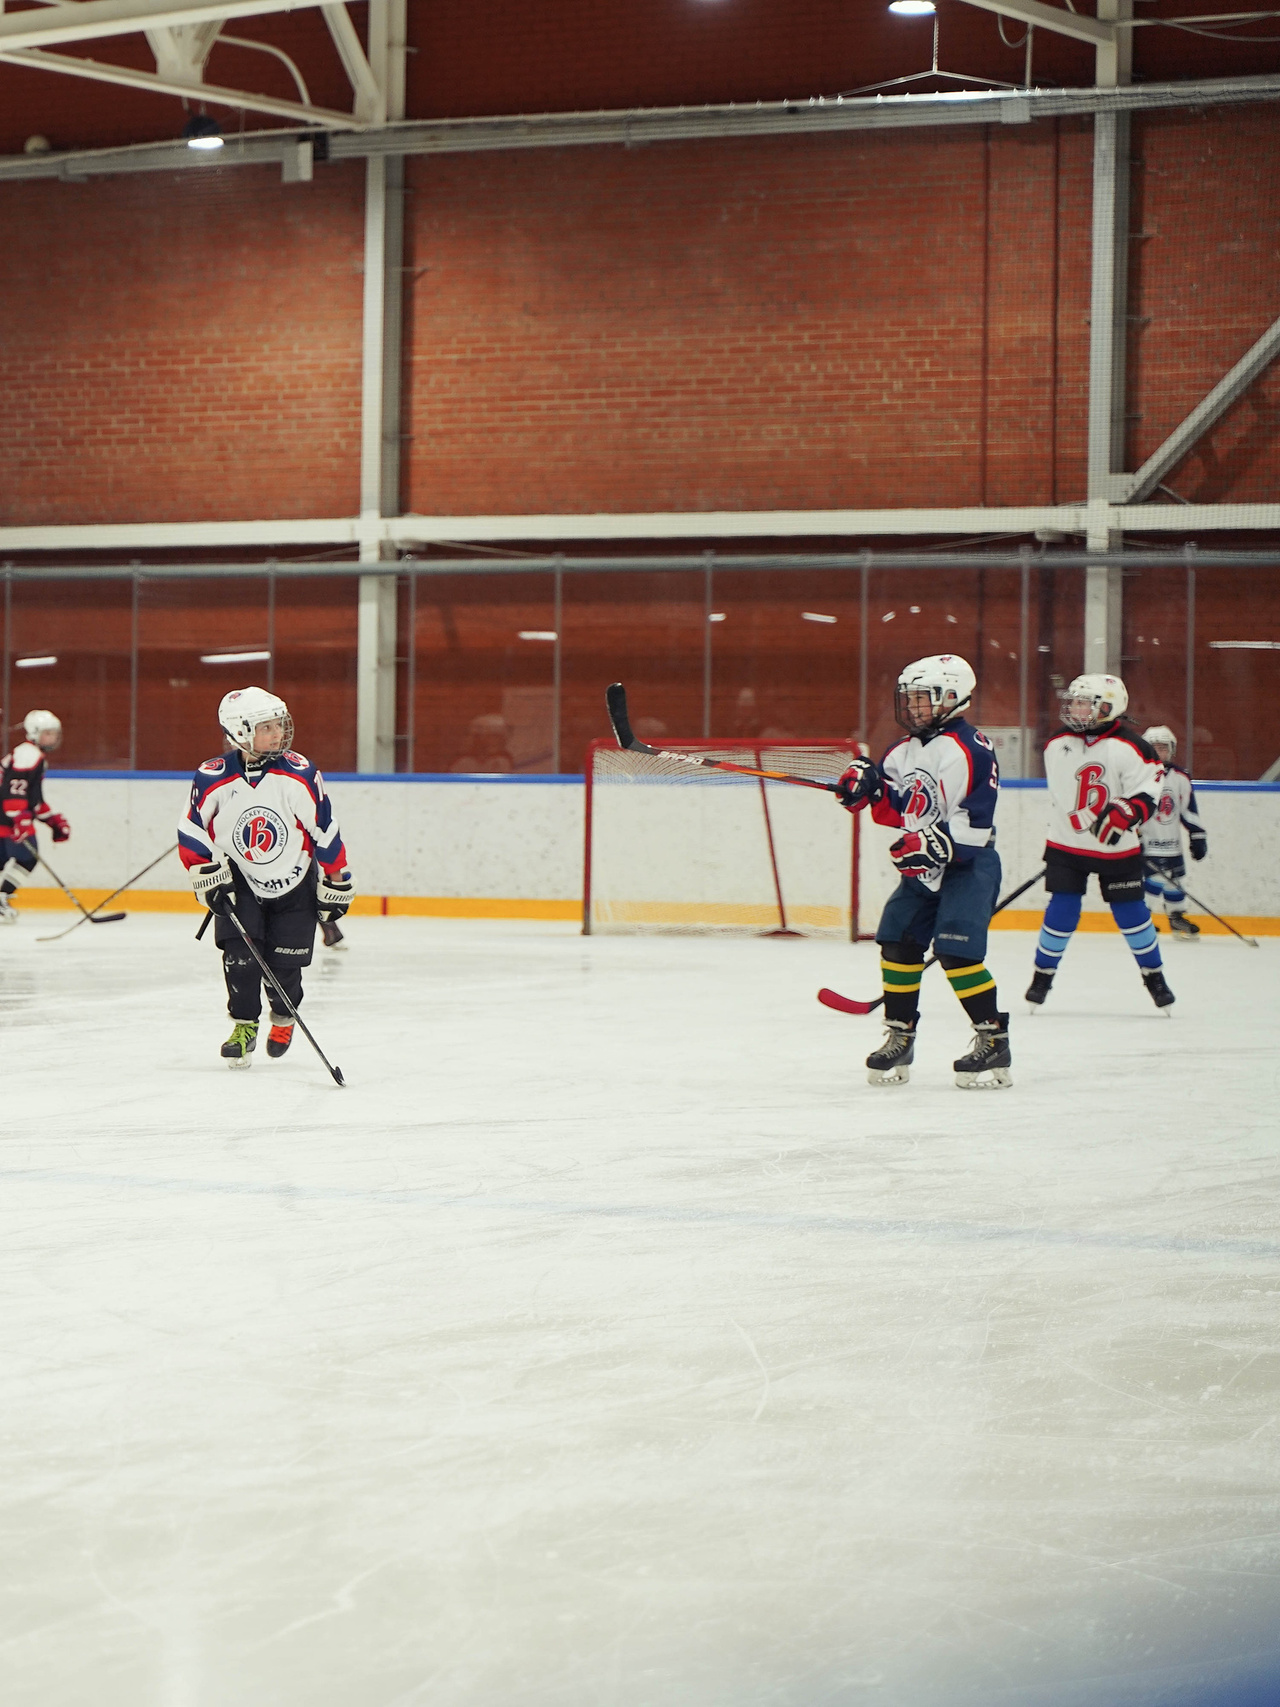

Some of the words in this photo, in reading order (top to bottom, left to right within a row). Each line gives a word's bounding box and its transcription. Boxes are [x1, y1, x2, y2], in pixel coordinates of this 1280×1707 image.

[10, 779, 28, 795] 22
[239, 809, 261, 828] HOCKEY
[262, 810, 278, 824] CLUB
[923, 827, 948, 858] STON
